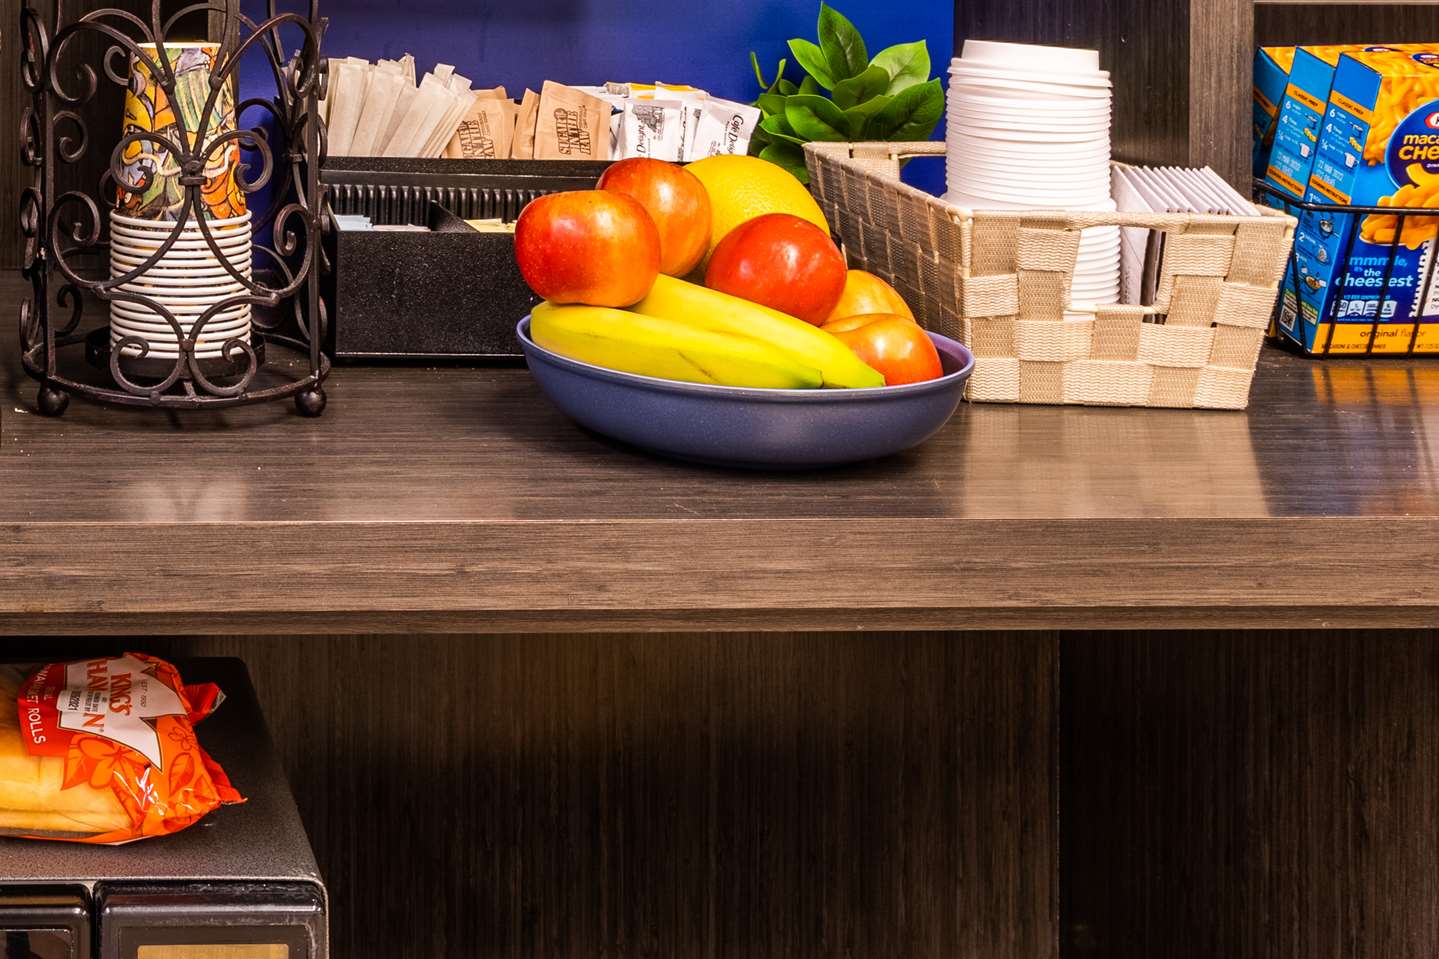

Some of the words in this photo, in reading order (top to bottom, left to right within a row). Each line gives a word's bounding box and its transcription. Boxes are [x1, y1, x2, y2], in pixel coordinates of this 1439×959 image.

[1363, 268, 1381, 277] the
[109, 672, 133, 717] KING'S
[28, 707, 46, 744] ROLLS
